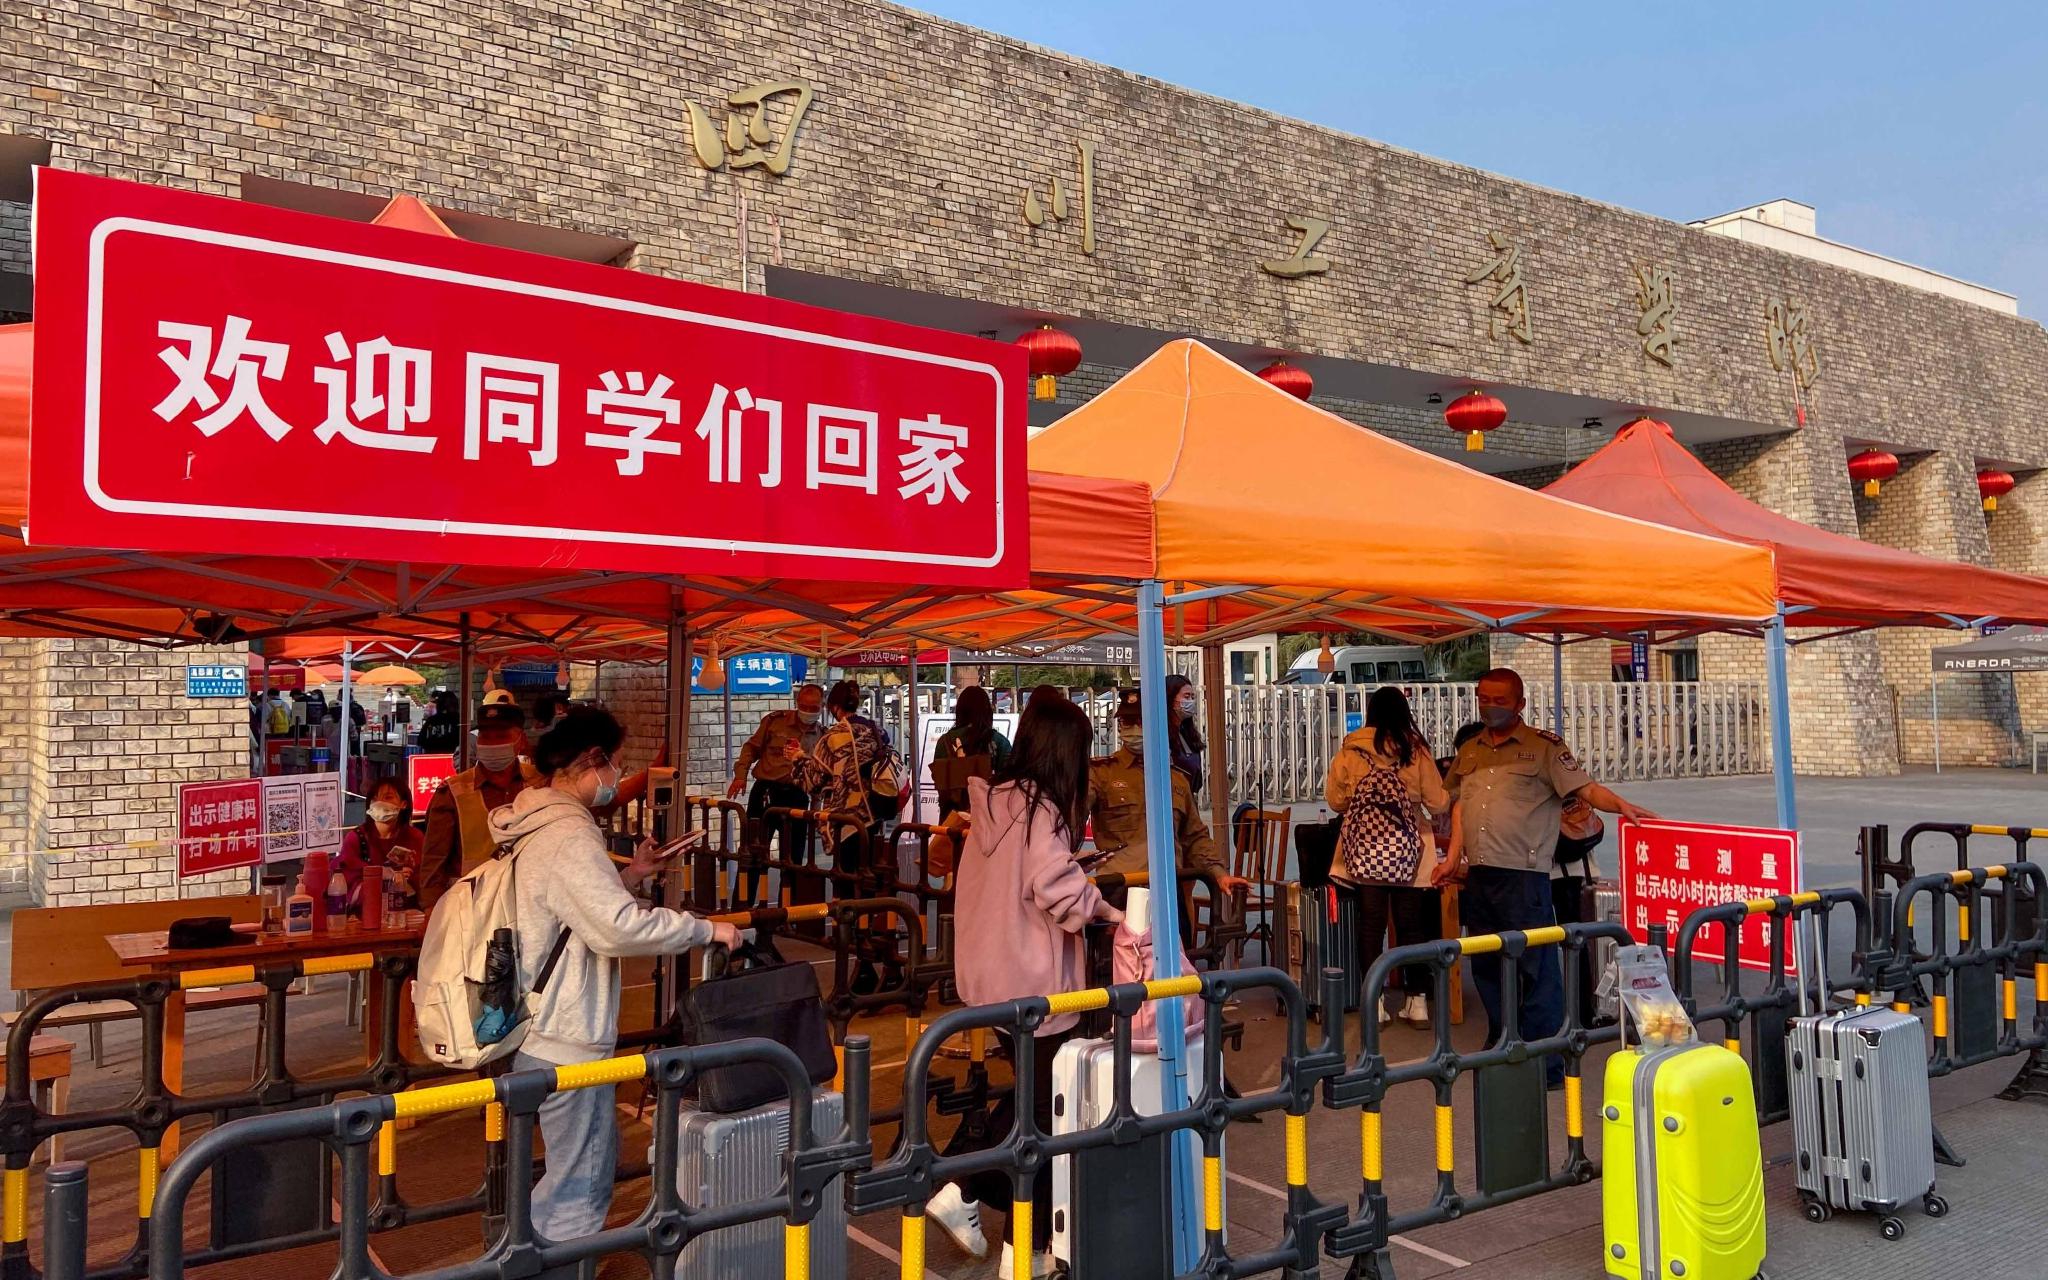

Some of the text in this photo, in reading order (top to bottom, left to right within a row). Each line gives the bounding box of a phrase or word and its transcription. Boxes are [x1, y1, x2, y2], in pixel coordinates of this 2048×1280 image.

[153, 315, 971, 505] 欢迎同学们回家
[736, 658, 786, 671] 车辆通道
[418, 776, 450, 794] 学生
[189, 798, 256, 827] 出示健康码
[189, 828, 257, 859] 扫场所码
